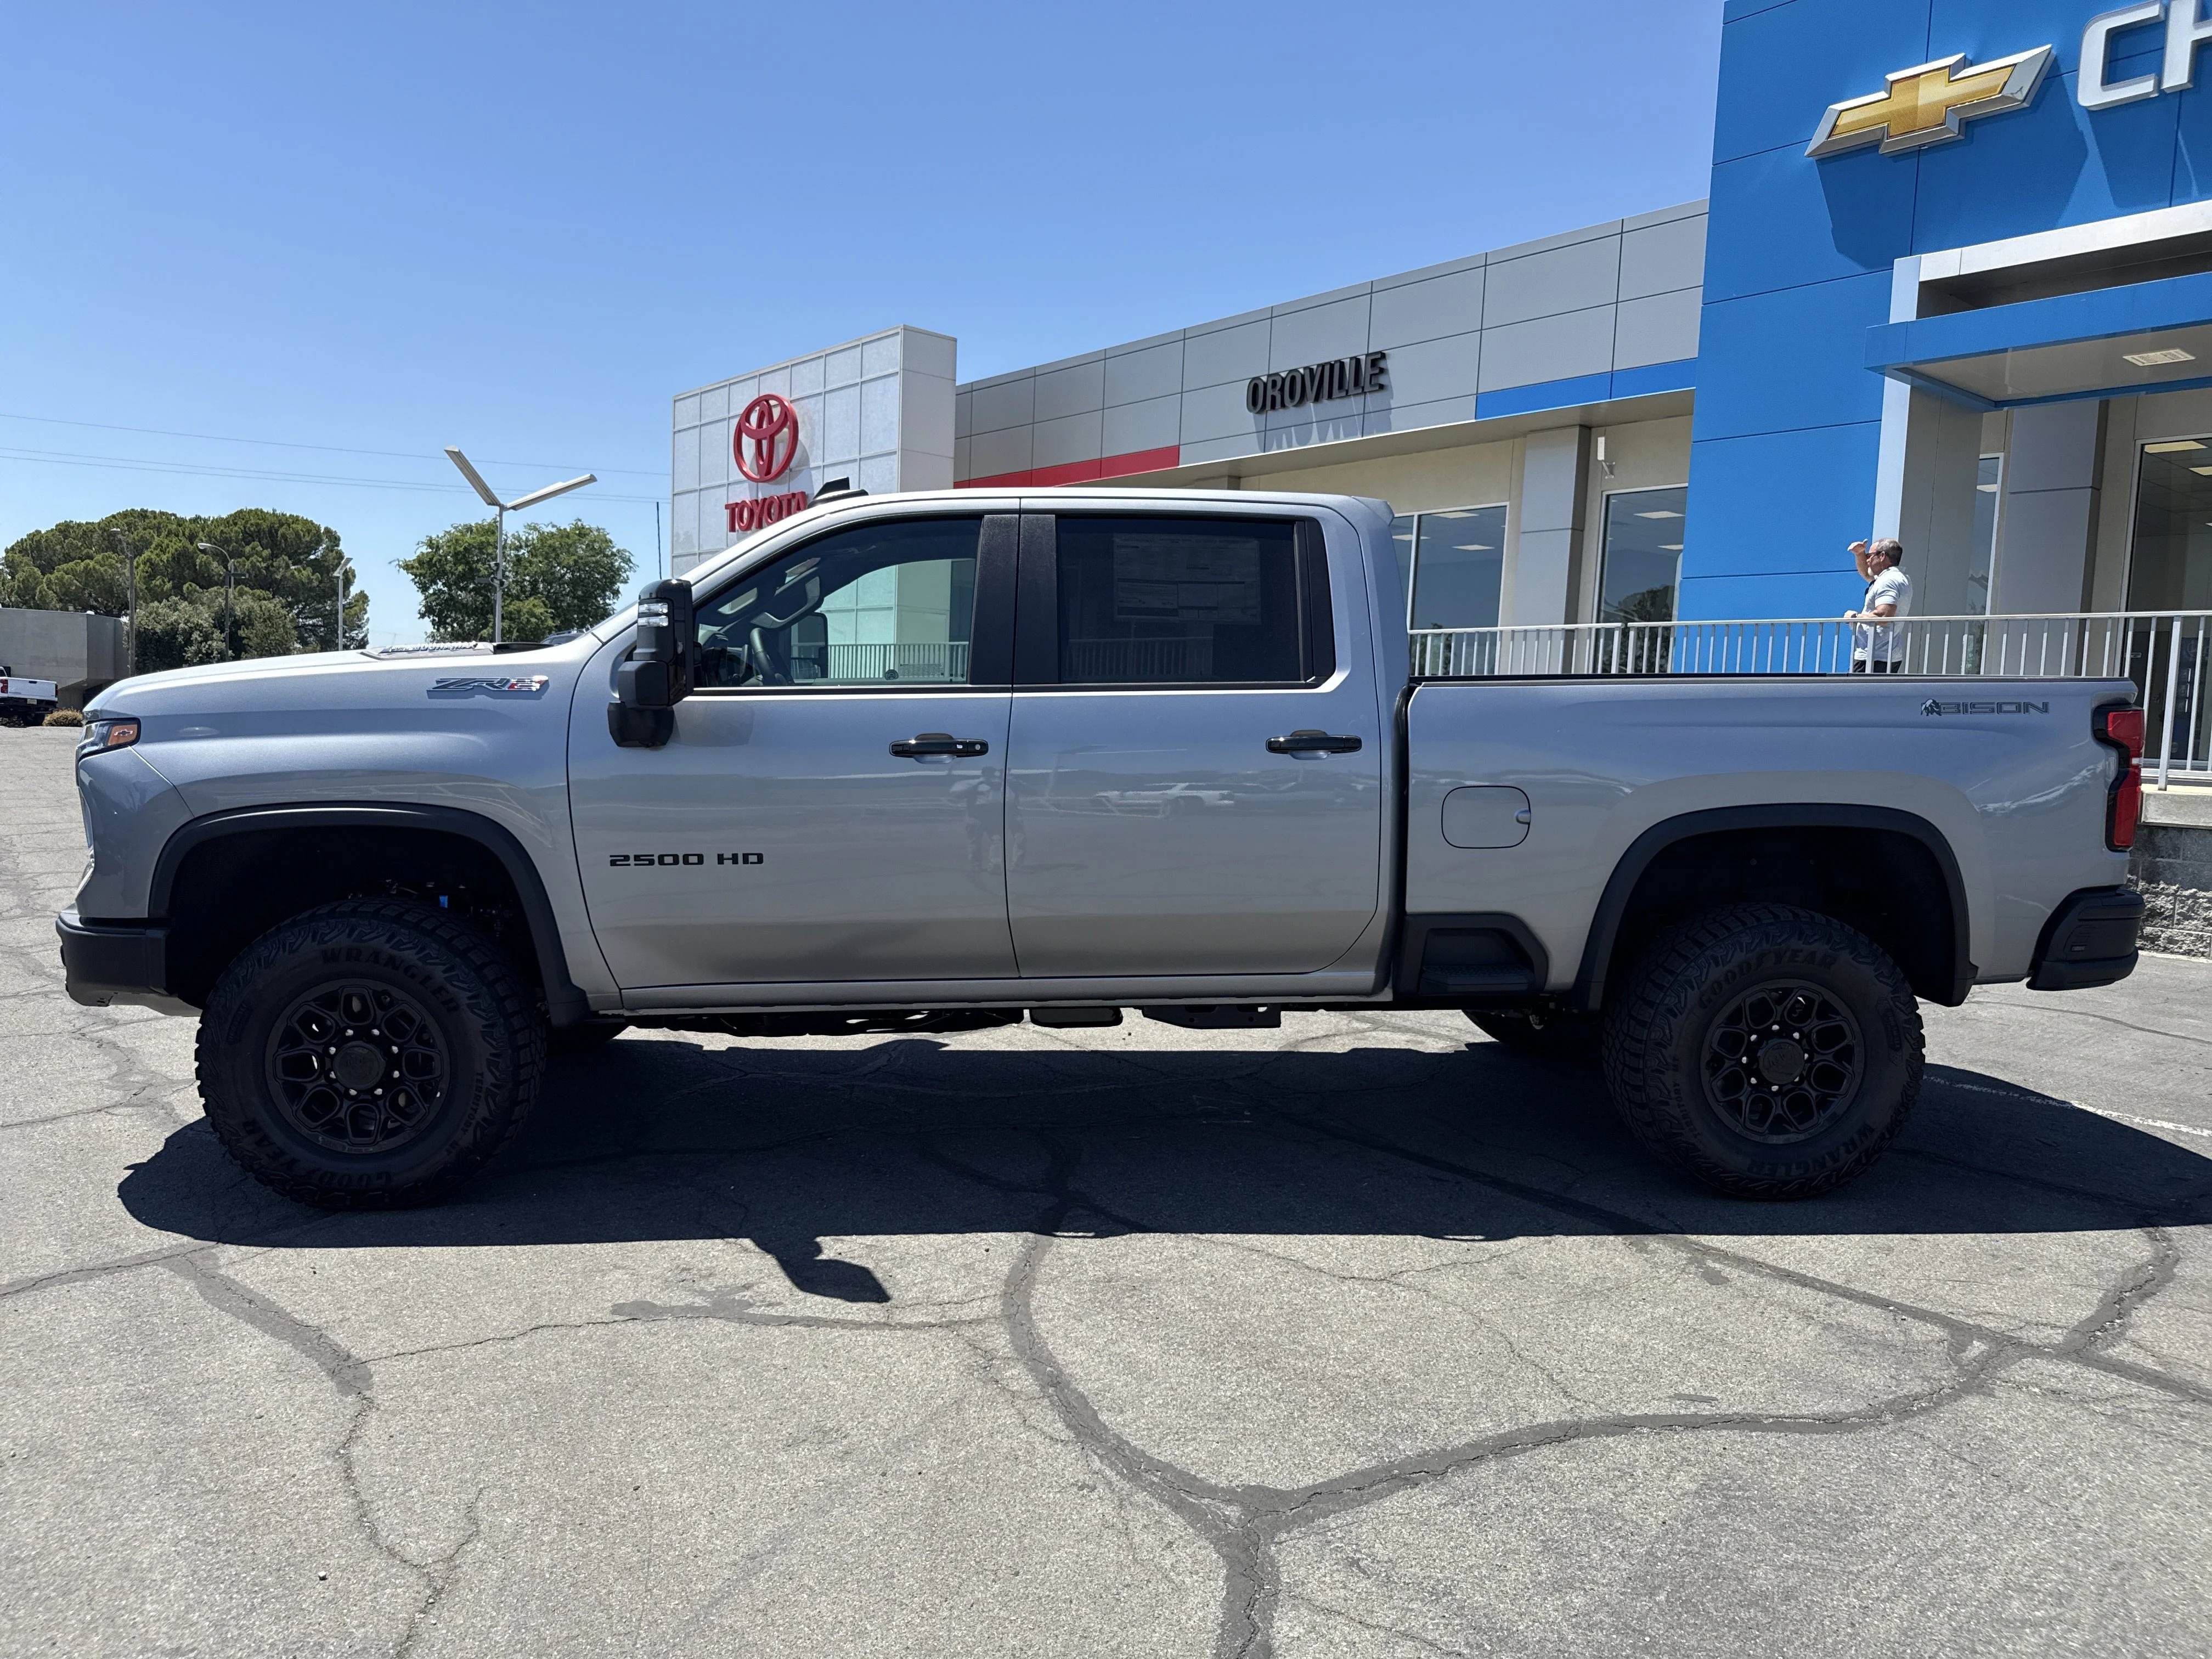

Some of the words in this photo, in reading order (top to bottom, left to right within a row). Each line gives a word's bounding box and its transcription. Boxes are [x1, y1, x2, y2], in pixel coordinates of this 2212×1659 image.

[1246, 351, 1386, 414] OROVILLE
[725, 491, 808, 533] TOYOTA
[1939, 702, 2050, 714] BISON
[610, 854, 704, 866] 2500
[717, 853, 764, 865] HD
[320, 946, 462, 1014] WRANGLER
[459, 1071, 485, 1135] TERRITORY
[1746, 1121, 1876, 1177] WRANGLER
